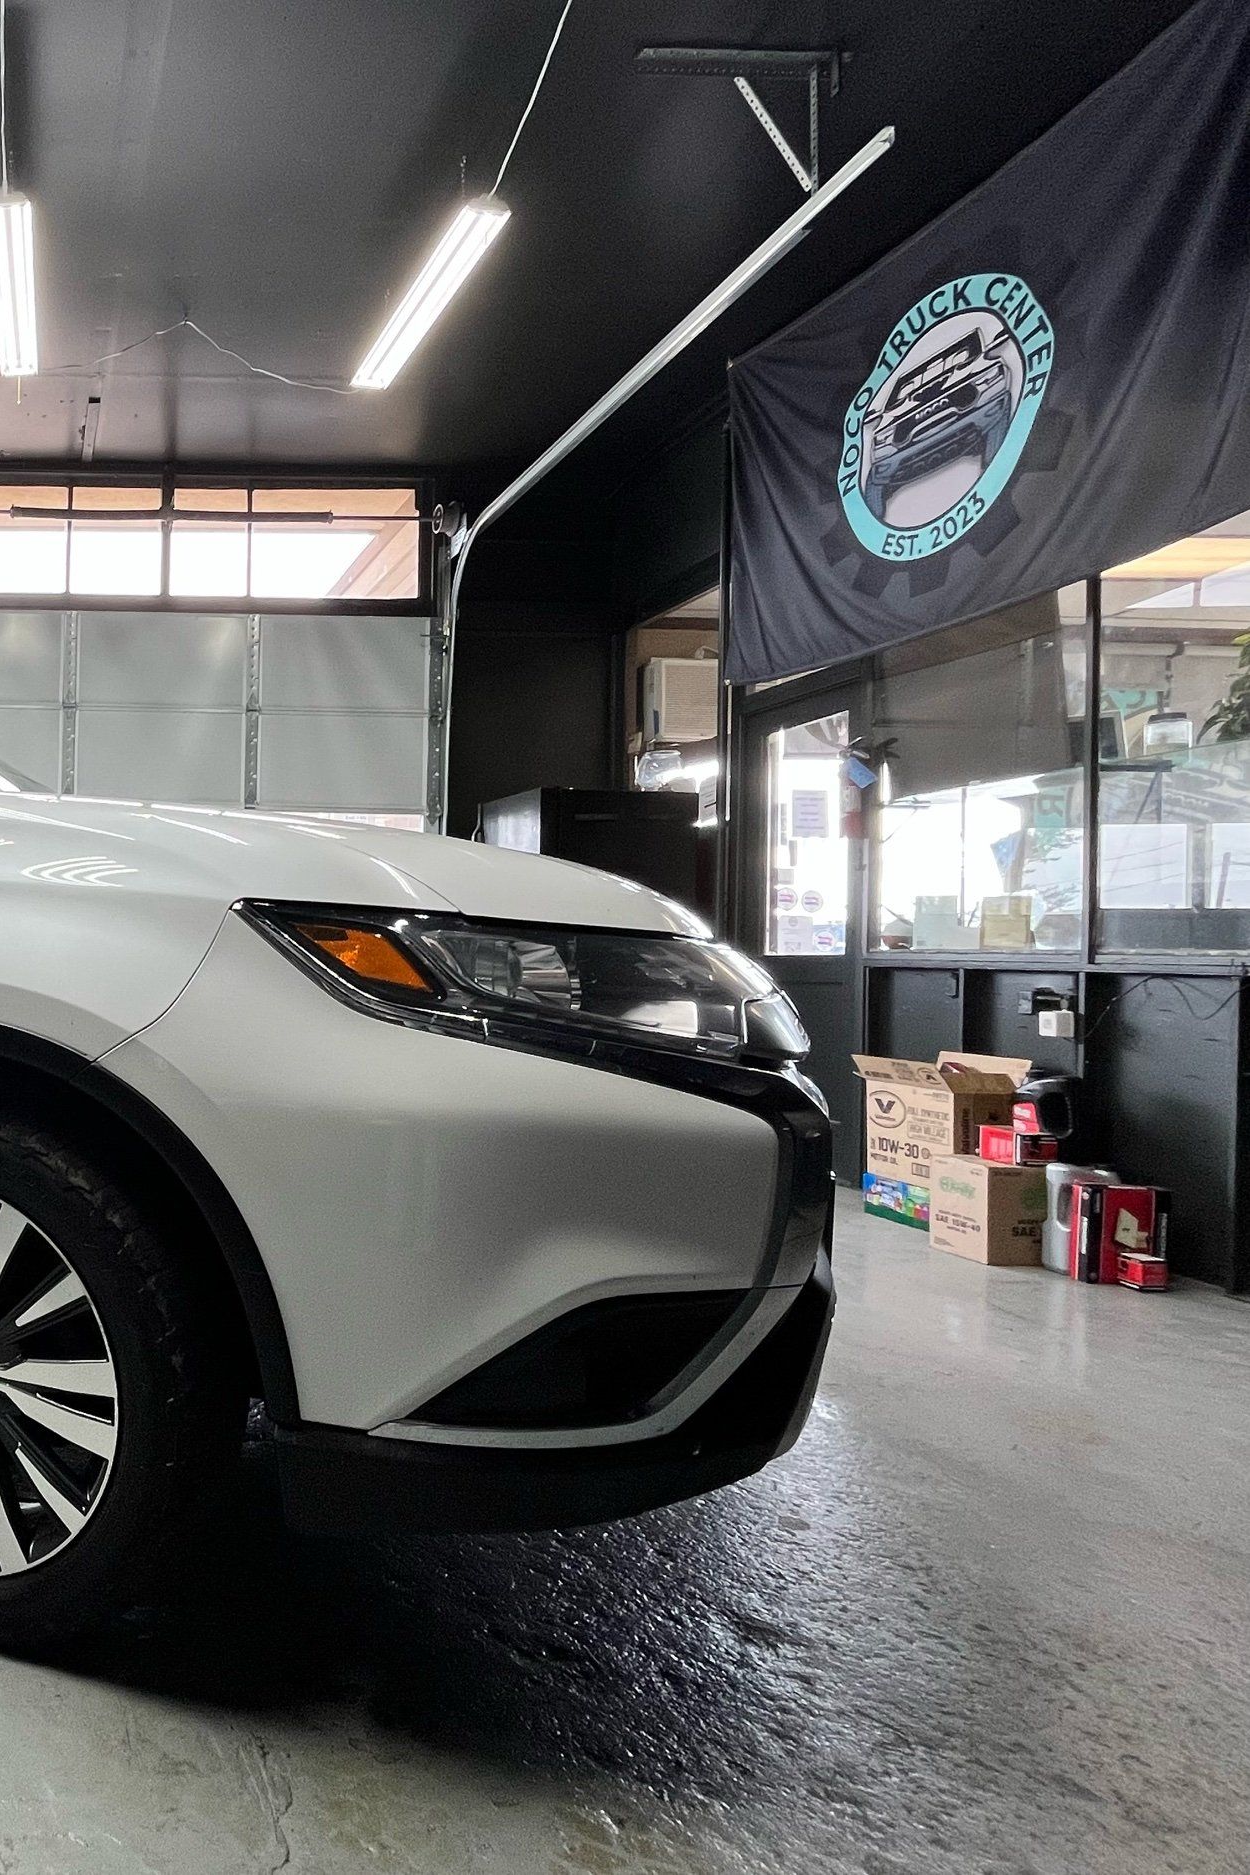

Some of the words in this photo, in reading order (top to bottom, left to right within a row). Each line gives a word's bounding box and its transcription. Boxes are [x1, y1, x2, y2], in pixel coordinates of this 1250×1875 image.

[840, 387, 872, 496] NOCO
[878, 279, 972, 372] TRUCK
[984, 276, 1050, 400] CENTER
[881, 533, 922, 556] EST.
[929, 492, 985, 546] 2023
[878, 1137, 919, 1159] 10W-30
